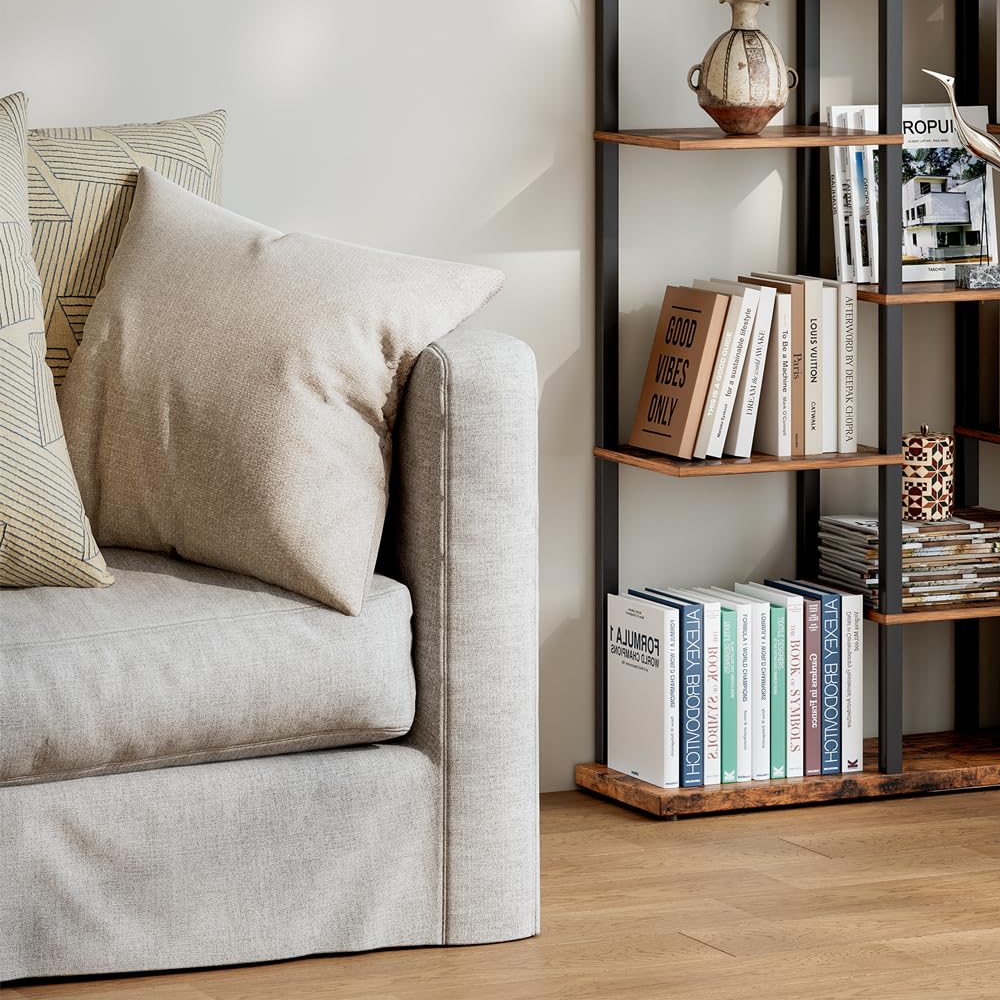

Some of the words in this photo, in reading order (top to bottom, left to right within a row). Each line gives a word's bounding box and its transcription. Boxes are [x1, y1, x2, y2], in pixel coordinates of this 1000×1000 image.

[903, 119, 956, 134] ROPUI
[665, 315, 698, 348] GOOD
[782, 330, 788, 339] To
[810, 318, 818, 345] LOUIS
[845, 296, 854, 353] AFTERWORD
[721, 331, 732, 356] GUIDE
[724, 386, 734, 397] for
[730, 337, 745, 379] sustainable
[739, 308, 752, 336] lifestyle
[754, 329, 766, 359] AWAKE
[782, 341, 788, 352] Be
[655, 353, 690, 388] VIBES
[715, 357, 726, 382] GOOD
[752, 358, 761, 376] world
[793, 353, 802, 380] Paris
[810, 346, 818, 383] VUITTON
[845, 355, 854, 367] BY
[712, 390, 719, 398] IS
[745, 385, 757, 416] DREAM
[845, 369, 854, 404] DEEPAK
[647, 393, 678, 427] ONLY
[707, 398, 717, 417] THIS
[845, 406, 854, 442] CHOPRA
[790, 639, 800, 676] BOOK
[790, 689, 800, 753] SYMBOLS
